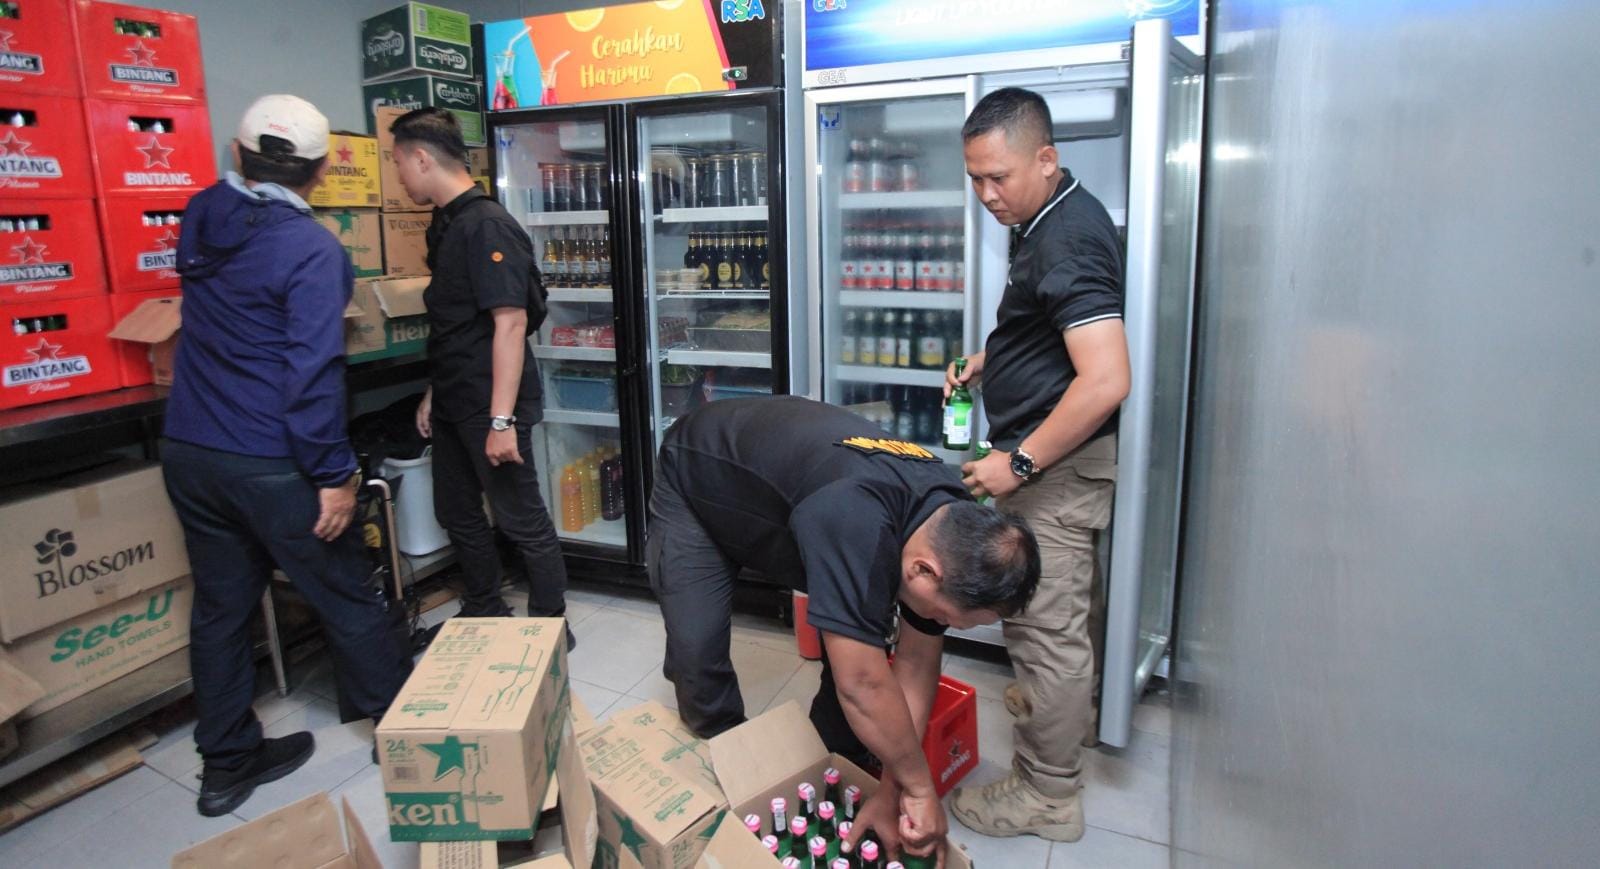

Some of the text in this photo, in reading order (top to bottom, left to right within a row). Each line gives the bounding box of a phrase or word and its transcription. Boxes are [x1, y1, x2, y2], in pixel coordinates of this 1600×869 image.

[721, 0, 765, 23] RSA
[592, 26, 684, 59] Cerahkan
[420, 45, 467, 70] Carlsberg
[117, 68, 173, 82] BINTANG
[580, 64, 654, 89] Harimu
[818, 70, 846, 85] GEA
[124, 171, 193, 186] BINTANG
[0, 264, 67, 281] BINTANG
[11, 359, 85, 382] BINTANG
[34, 541, 155, 598] Blossom
[51, 587, 173, 662] See-U
[76, 645, 114, 669] HAND
[118, 620, 171, 651] TOWELS
[385, 739, 406, 753] 24
[386, 796, 460, 827] ken
